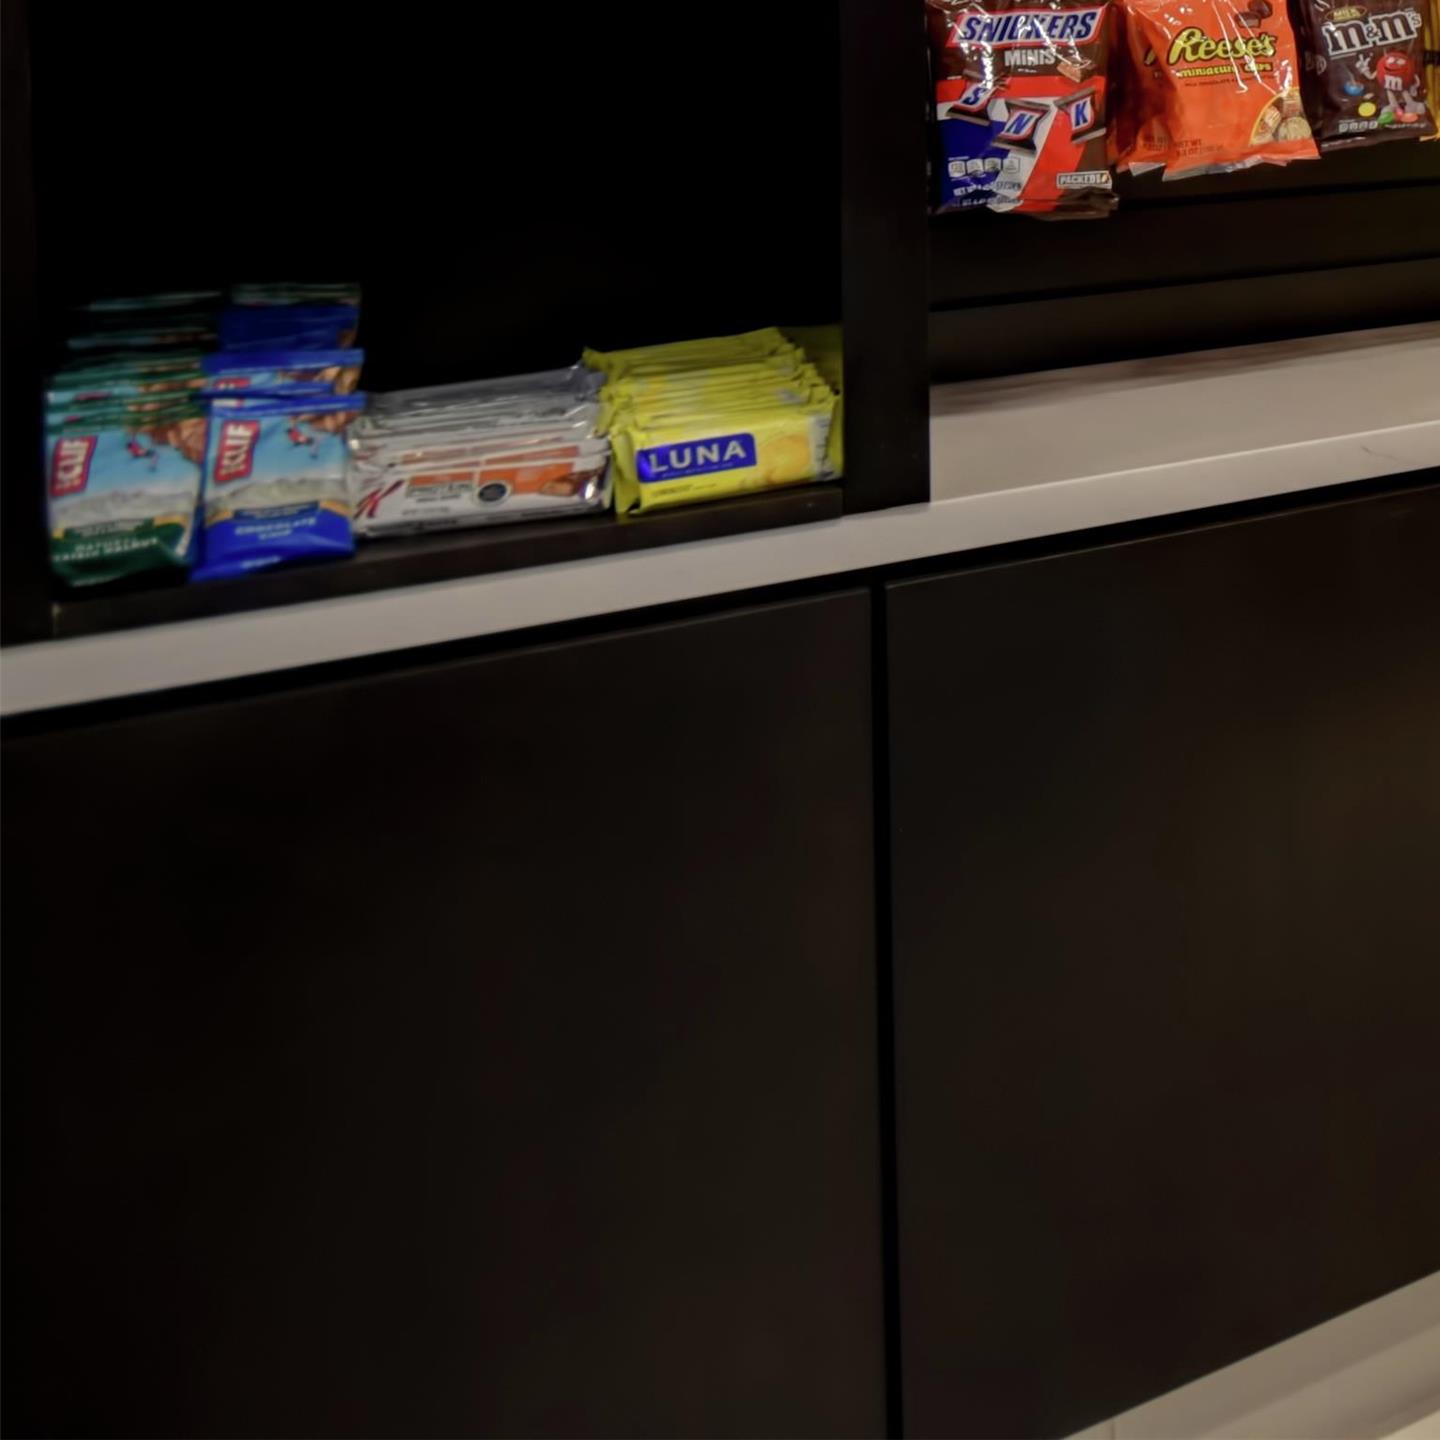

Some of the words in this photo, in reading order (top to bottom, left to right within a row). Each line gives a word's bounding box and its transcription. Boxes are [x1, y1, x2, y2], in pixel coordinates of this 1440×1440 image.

[962, 11, 1098, 40] SNICKERS
[1168, 26, 1277, 66] Reese's
[649, 438, 747, 474] LUNA
